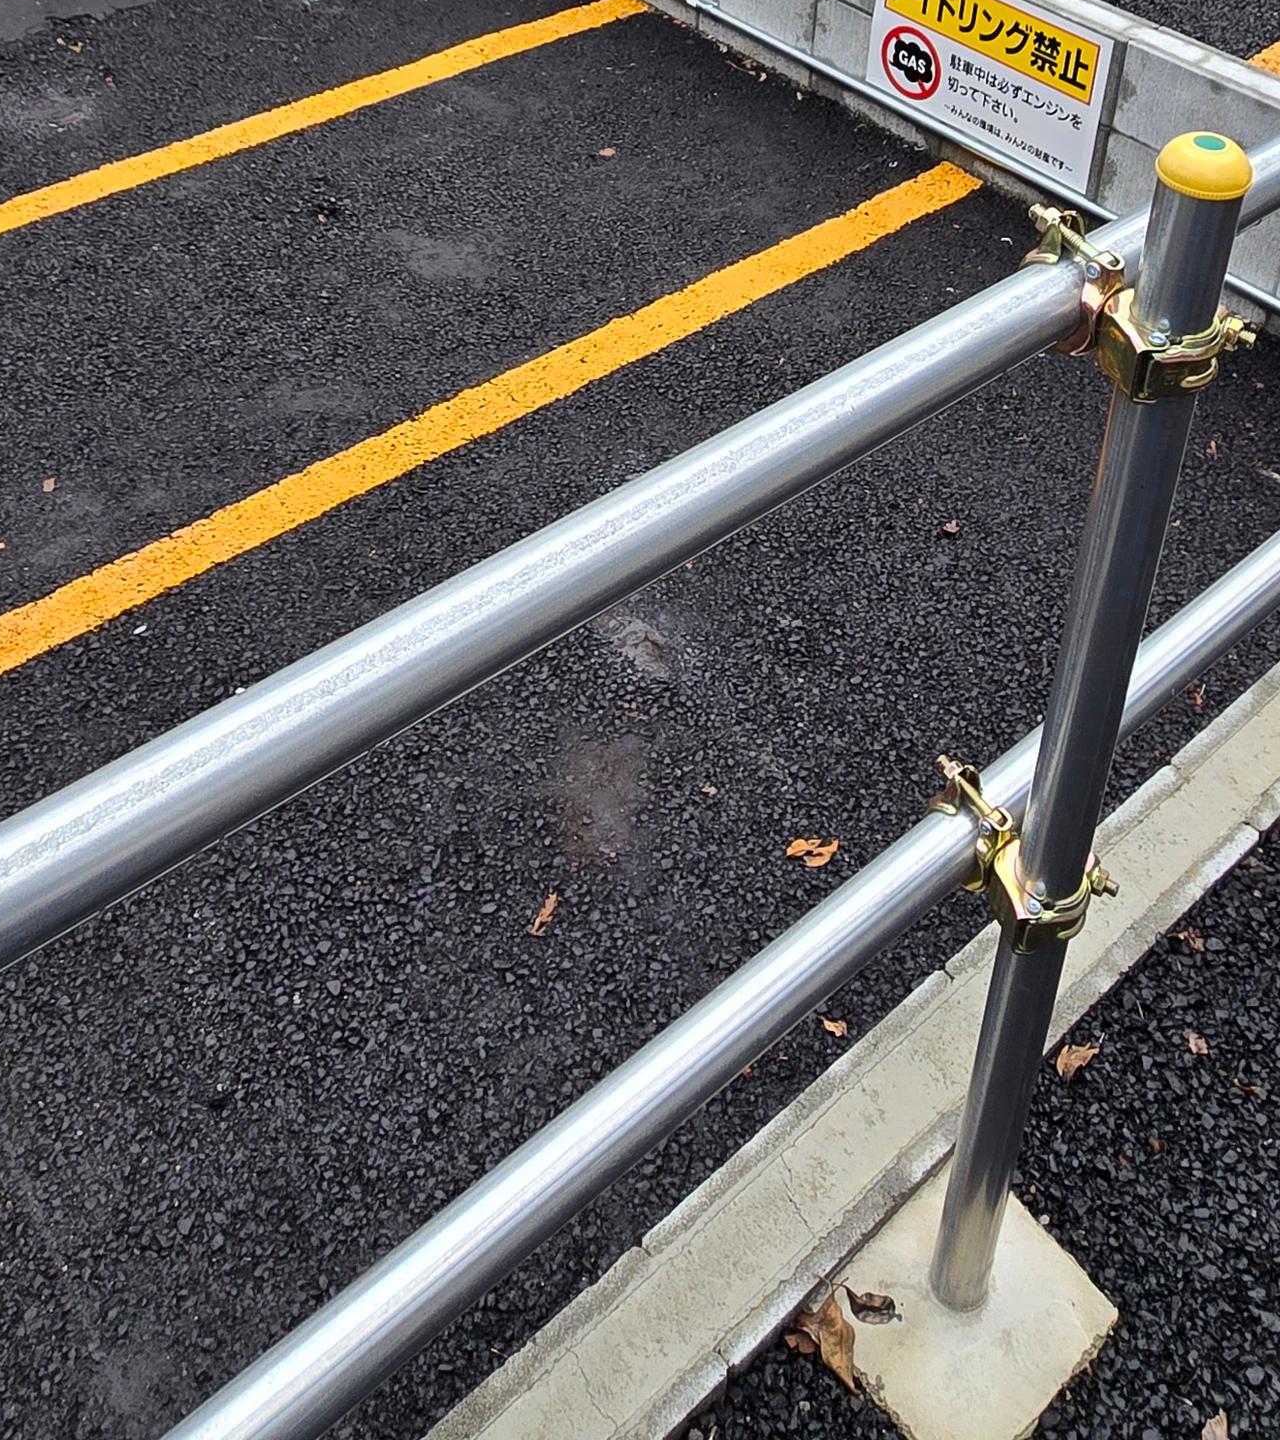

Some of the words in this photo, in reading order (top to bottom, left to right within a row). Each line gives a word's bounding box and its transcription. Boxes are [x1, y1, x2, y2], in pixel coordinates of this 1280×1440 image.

[898, 50, 926, 75] GAS
[946, 76, 1020, 124] 切って下さい。
[949, 54, 1083, 131] 駐車中は必ずエンジンを
